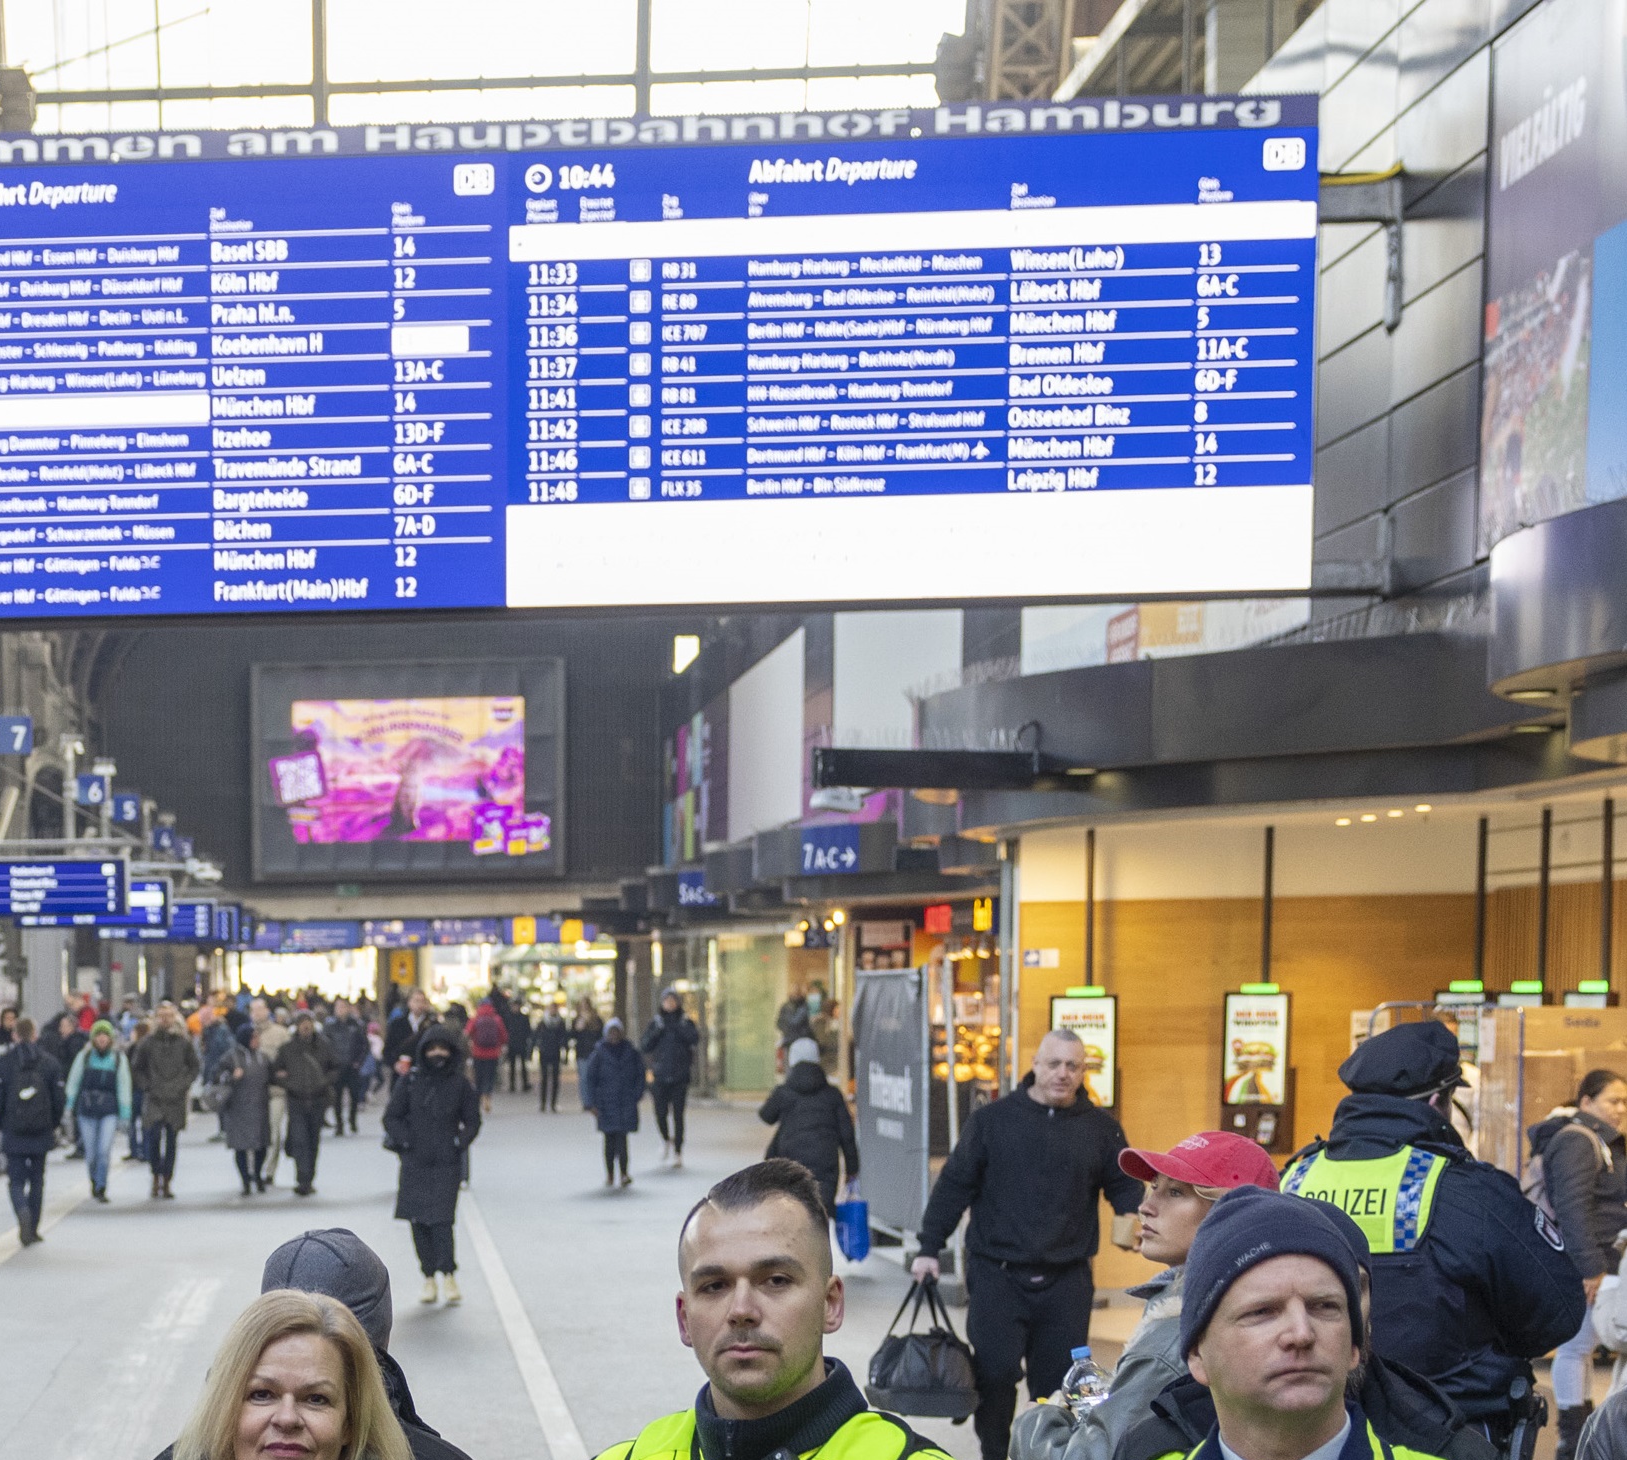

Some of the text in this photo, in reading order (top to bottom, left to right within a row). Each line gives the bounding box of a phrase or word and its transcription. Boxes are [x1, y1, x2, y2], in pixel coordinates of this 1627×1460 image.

[227, 128, 339, 157] am
[364, 109, 911, 153] Hauptbahnhof
[933, 99, 1282, 134] Hamburg
[1499, 75, 1588, 192] VIELFÄLTIG
[559, 164, 615, 189] 10:44
[749, 157, 917, 185] Abfahrt Departure
[29, 182, 117, 209] Departure
[211, 239, 288, 262] Basel SBB
[394, 236, 415, 257] 14
[1009, 244, 1125, 271] Winsen(Luhe)
[1197, 242, 1222, 266] 13
[211, 270, 279, 293] Köln Hbf
[394, 267, 415, 288] 12
[527, 261, 577, 285] 11:33
[1010, 276, 1103, 302] Lübeck Hbf
[211, 303, 254, 325] Praha
[394, 299, 405, 320] 5
[527, 293, 578, 316] 11:34
[1010, 308, 1119, 334] München Hbf
[1197, 305, 1211, 329] 5
[212, 332, 323, 355] Koebenhavn H
[527, 324, 578, 348] 11:36
[1010, 340, 1107, 366] Bremen Hbf
[212, 365, 265, 387] Uelzen
[529, 356, 577, 379] 11:37
[1009, 372, 1115, 397] Bad Oldesloe
[211, 394, 315, 417] München Hbf
[395, 391, 416, 413] 14
[528, 387, 576, 410] 11:41
[1008, 404, 1130, 429] Ostseebad Binz
[1194, 400, 1209, 422] 8
[213, 427, 271, 448] Itzehoe
[529, 418, 577, 441] 11:42
[1008, 435, 1116, 460] München Hbf
[1195, 432, 1219, 455] 14
[213, 455, 361, 480] Travemünde Strand
[528, 449, 578, 472] 11:46
[1008, 466, 1100, 491] Leipzig Hbf
[1195, 463, 1218, 486] 12
[213, 488, 309, 512] Bargteheide
[529, 480, 577, 503] 11:48
[214, 519, 271, 540] Büchen
[214, 548, 316, 570] München Hbf
[396, 546, 416, 567] 12
[214, 578, 368, 602] Frankfurt(Main)Hbf
[396, 577, 417, 597] 12
[9, 724, 28, 752] 7
[87, 782, 103, 803] 6
[122, 800, 137, 821] 5
